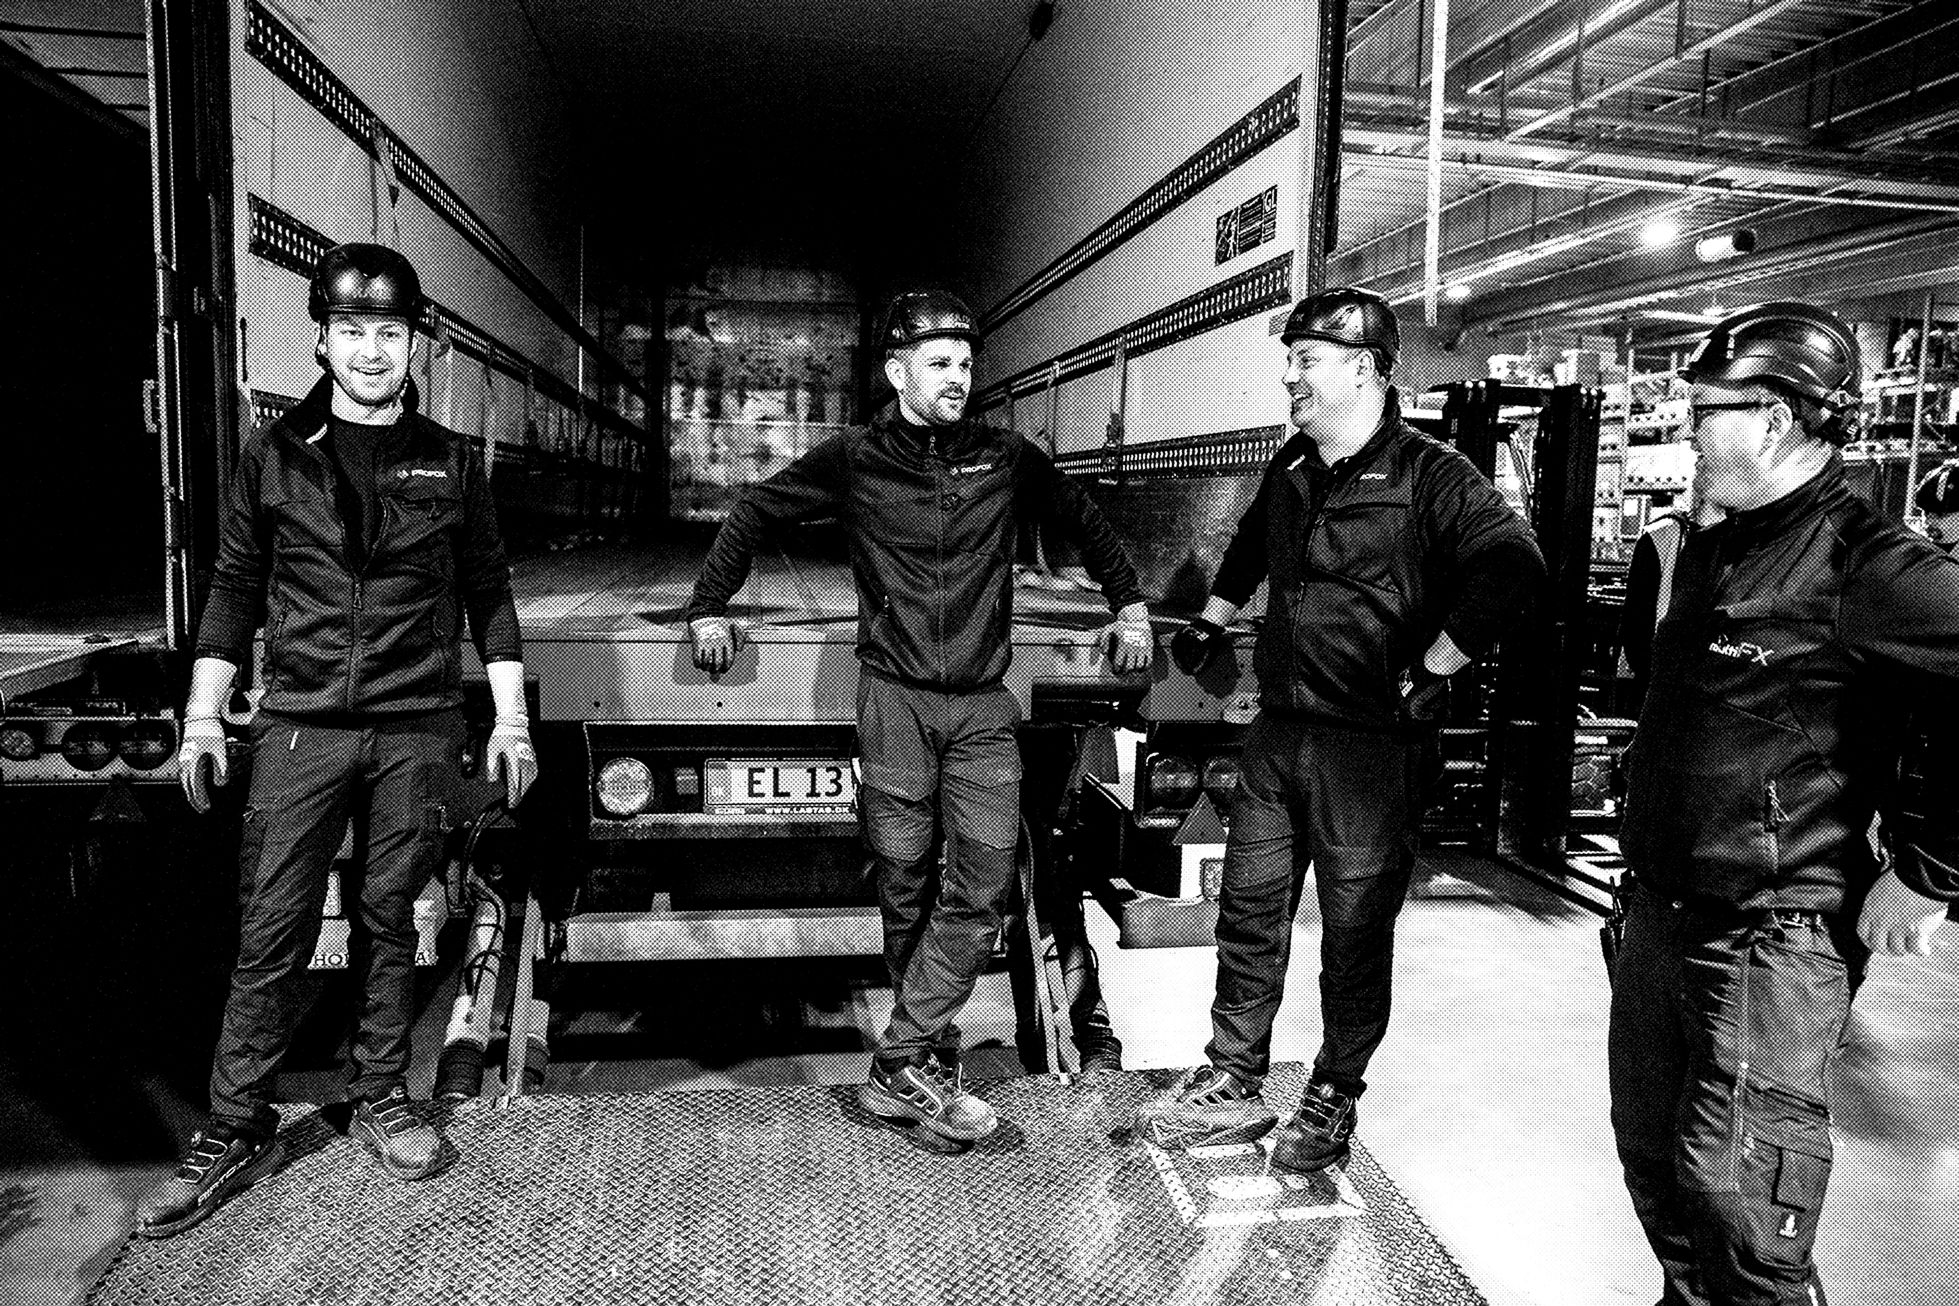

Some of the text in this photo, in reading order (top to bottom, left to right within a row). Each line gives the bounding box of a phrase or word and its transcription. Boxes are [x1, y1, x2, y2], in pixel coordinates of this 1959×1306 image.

[960, 463, 992, 474] PROFOX
[748, 766, 843, 798] EL 13
